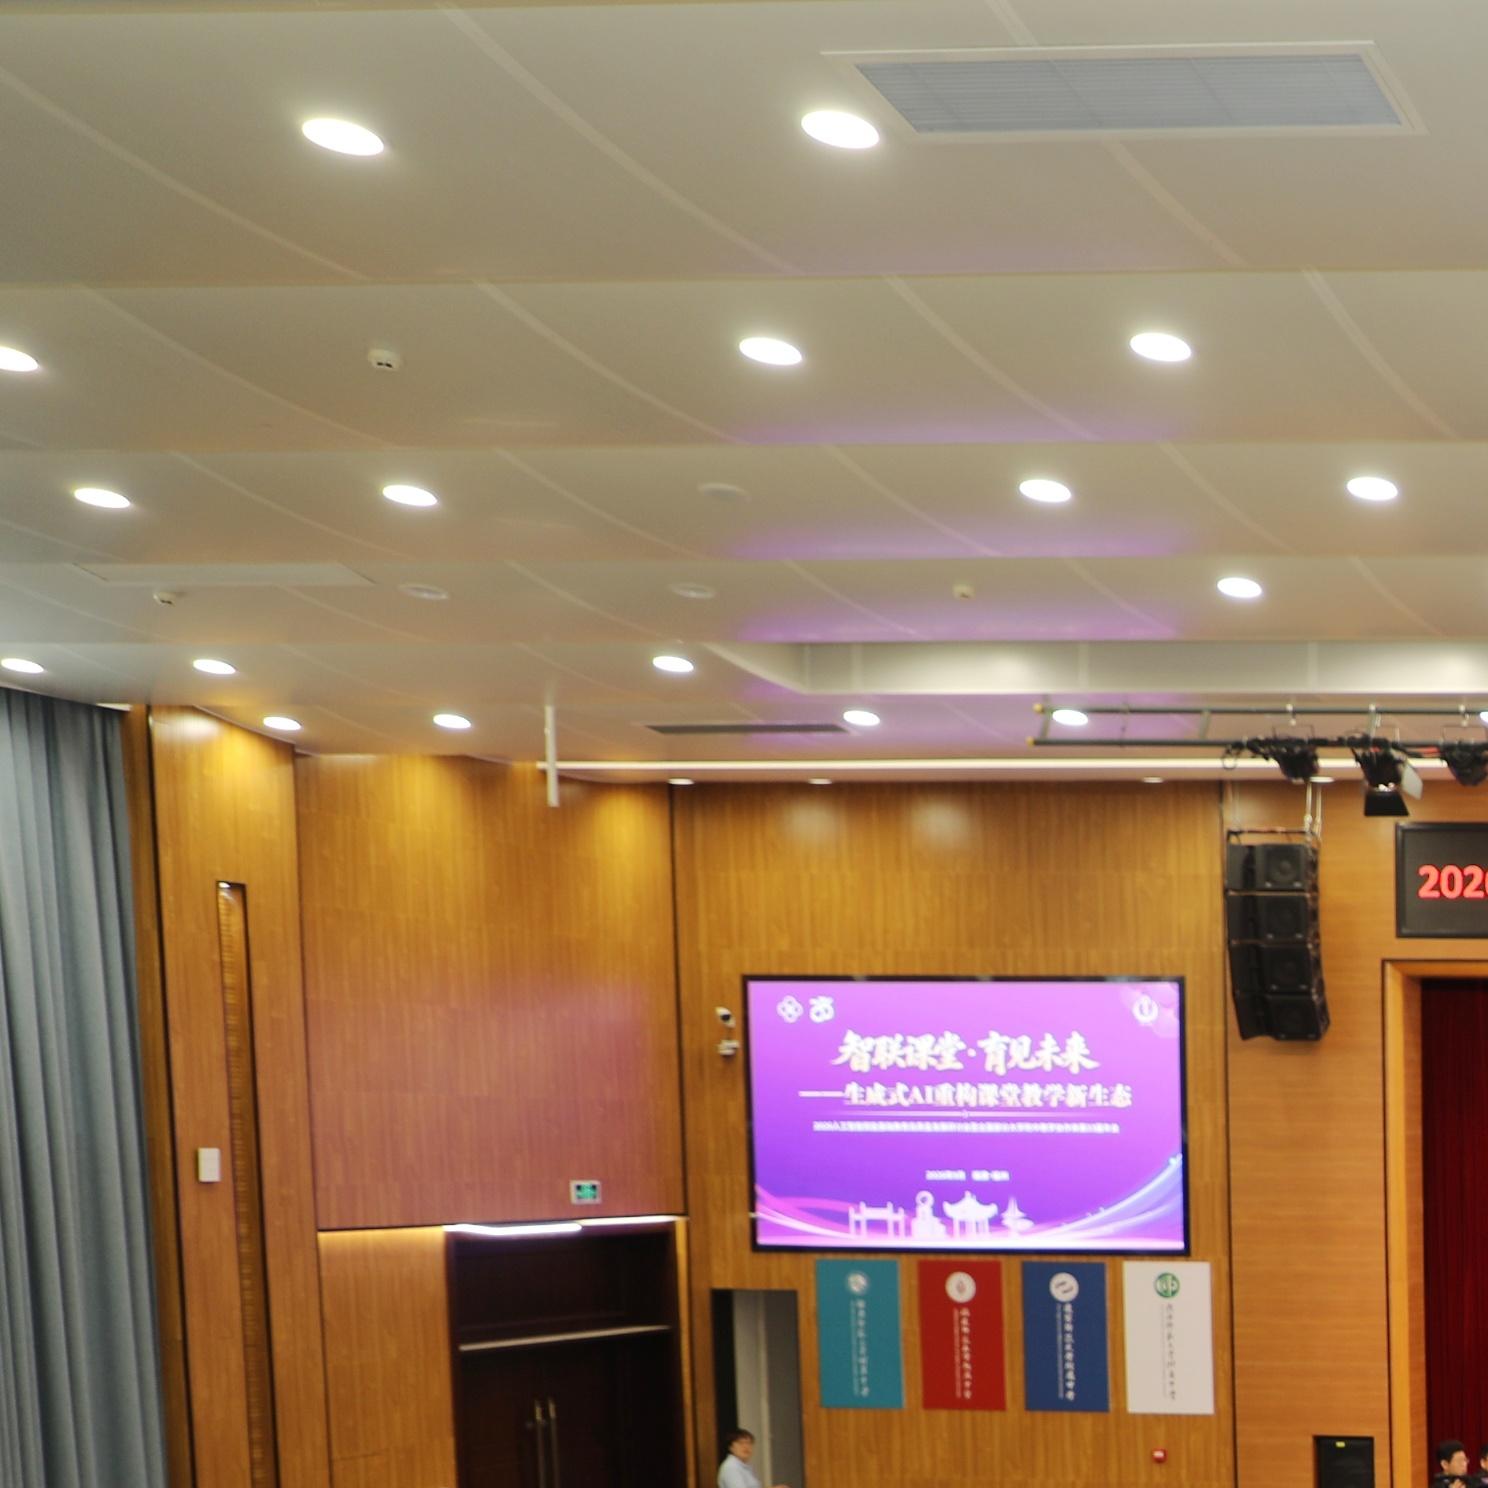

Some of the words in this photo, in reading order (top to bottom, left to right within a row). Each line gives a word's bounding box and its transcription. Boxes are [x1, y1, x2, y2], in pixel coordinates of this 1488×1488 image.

[832, 1030, 1100, 1074] 智联课堂·育见未来
